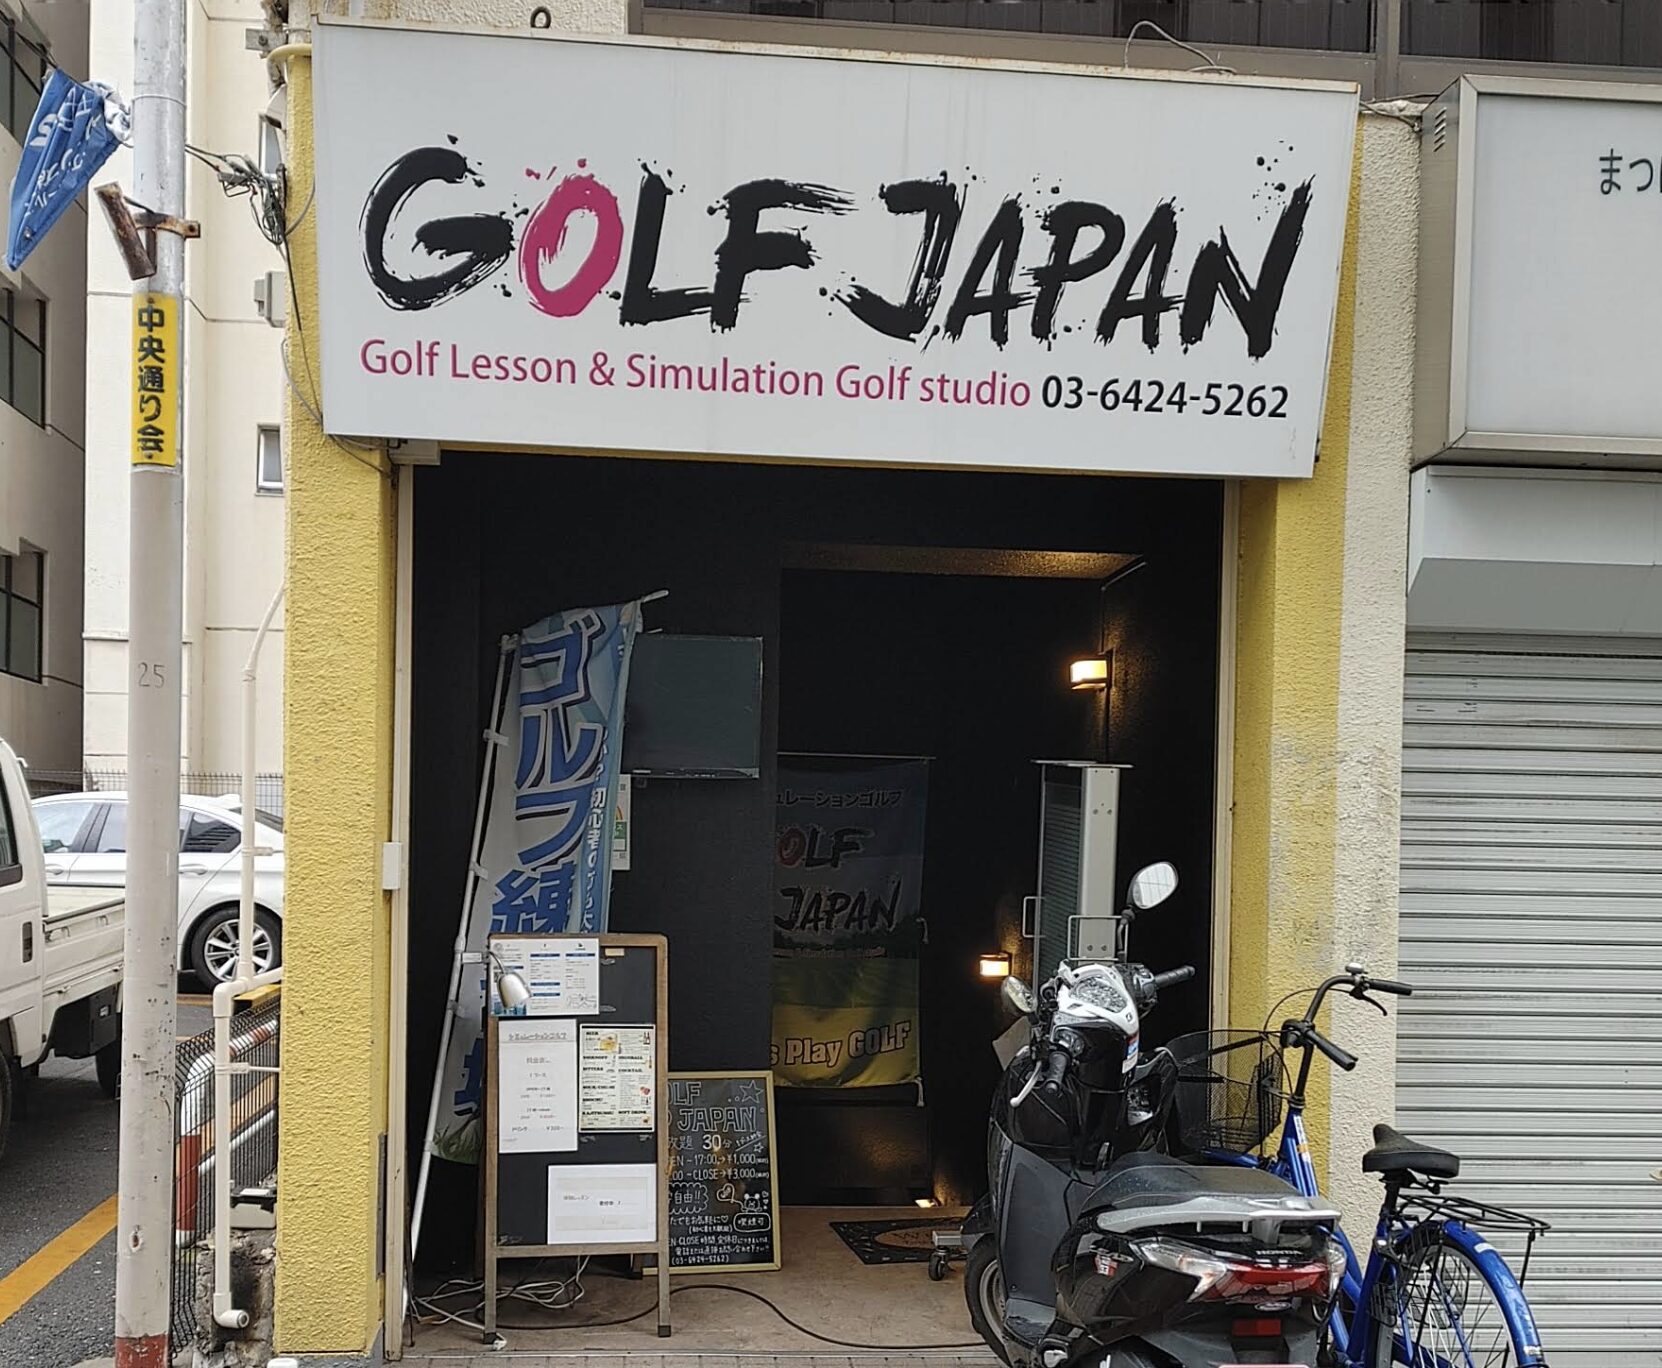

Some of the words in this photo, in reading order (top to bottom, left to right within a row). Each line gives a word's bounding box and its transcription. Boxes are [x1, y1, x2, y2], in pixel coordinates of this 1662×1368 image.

[1599, 148, 1662, 195] まつ
[359, 141, 856, 332] GOLF
[830, 172, 1316, 361] JAPAN
[138, 303, 165, 453] 中央通り会
[360, 339, 440, 376] Golf
[451, 344, 576, 384] Lesson
[589, 352, 615, 386] &
[626, 353, 824, 396] Simulation
[835, 365, 912, 401] Golf
[919, 371, 1031, 407] studio
[1041, 374, 1289, 418] 03-6424-5262
[138, 662, 166, 689] 25
[776, 826, 876, 869] OLF
[774, 878, 902, 932] JAPAN
[785, 1037, 843, 1068] Play
[848, 1019, 912, 1058] GOLF
[677, 1106, 757, 1133] JAPAN
